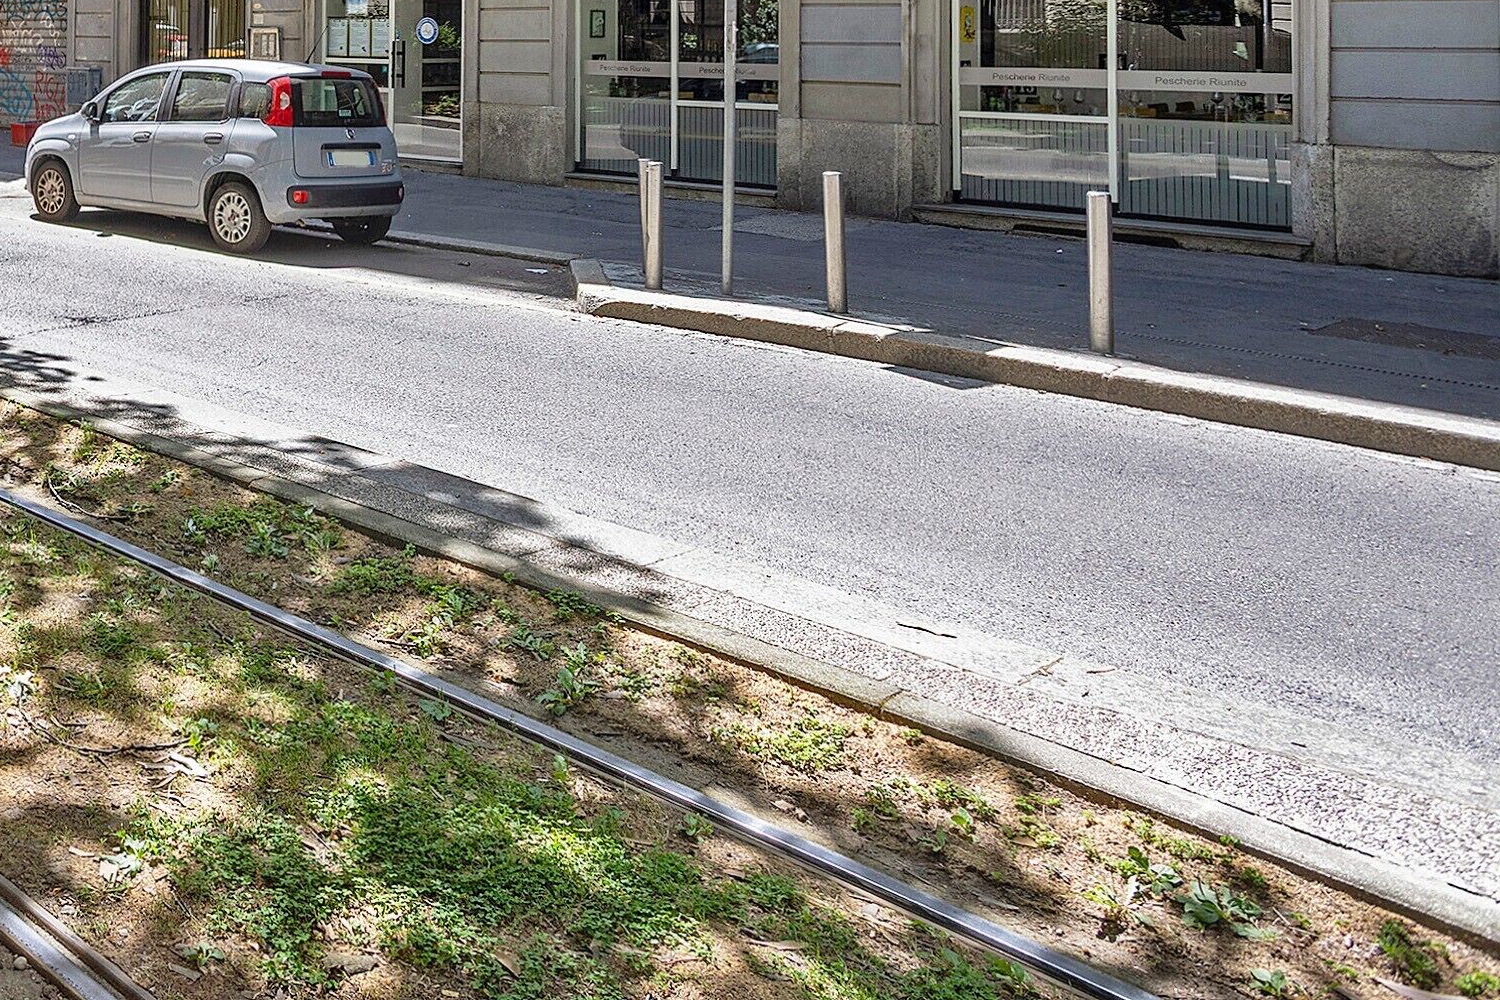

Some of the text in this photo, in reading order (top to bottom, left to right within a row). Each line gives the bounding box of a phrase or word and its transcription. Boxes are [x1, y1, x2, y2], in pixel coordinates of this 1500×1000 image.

[992, 72, 1071, 82] Pescherie Riunite
[1155, 76, 1247, 87] Pescherie Riunite
